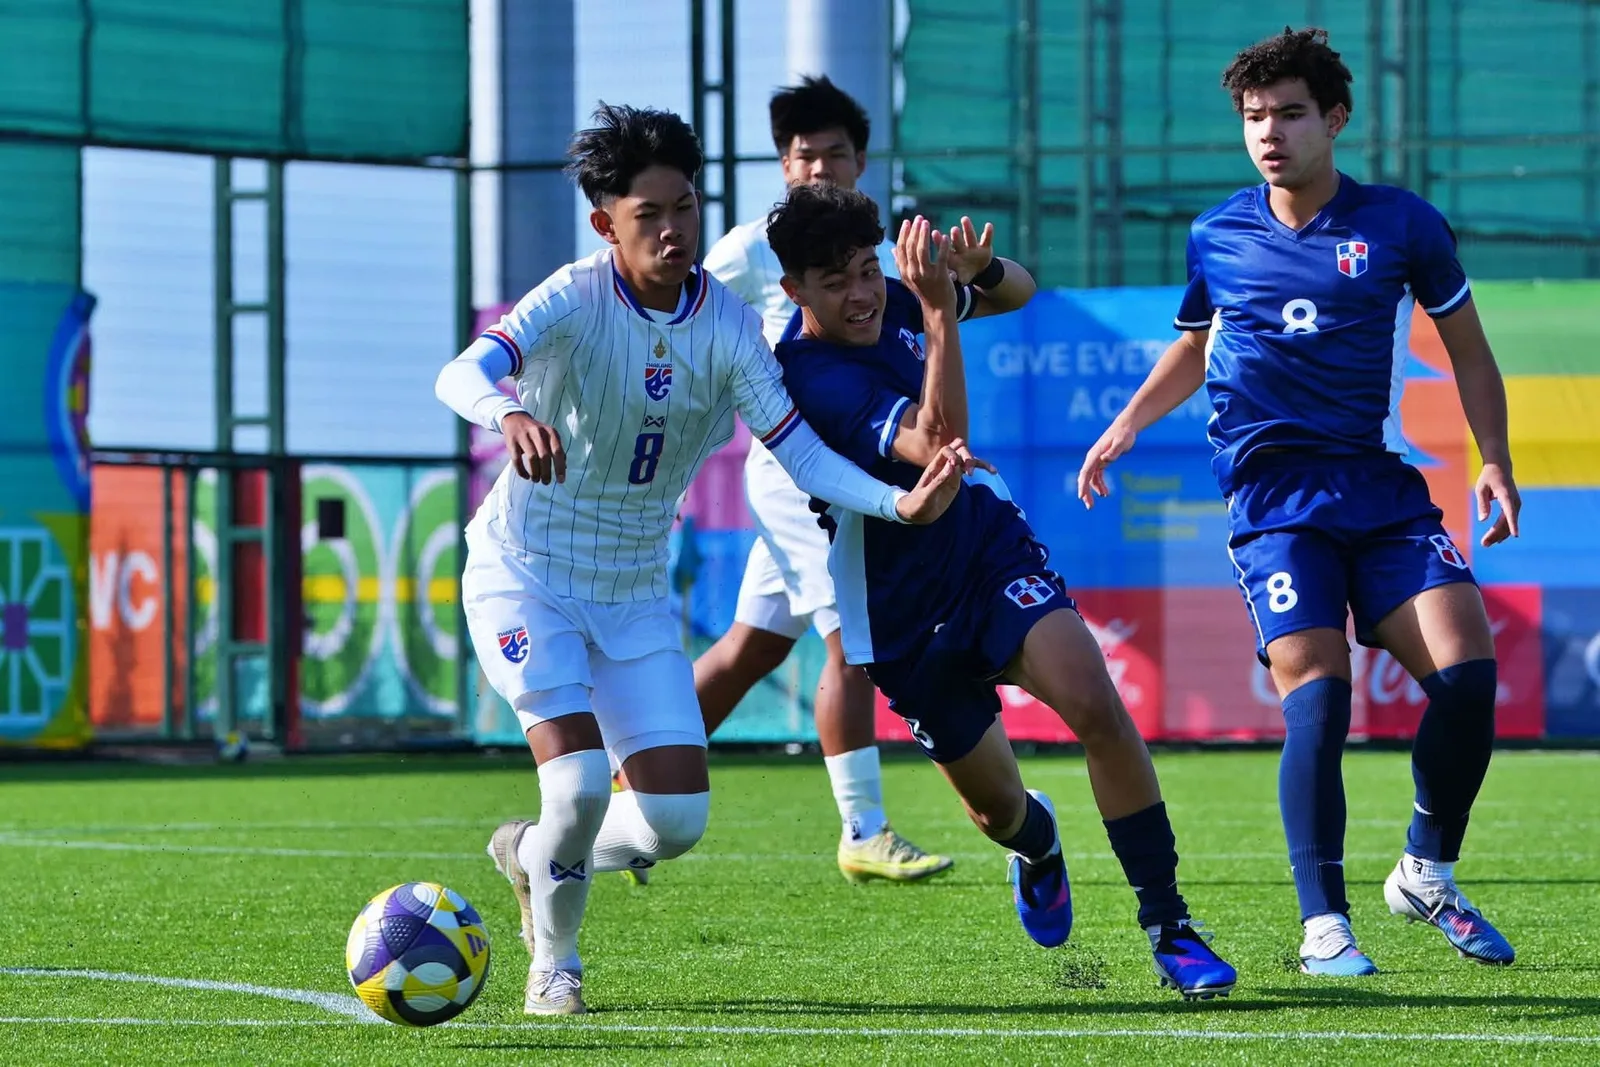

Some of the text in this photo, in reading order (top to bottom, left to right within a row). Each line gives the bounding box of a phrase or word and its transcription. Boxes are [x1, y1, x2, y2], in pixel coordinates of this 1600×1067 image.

[1282, 299, 1319, 334] 8
[988, 340, 1171, 377] GIVE EVER
[1068, 386, 1095, 421] A
[628, 433, 665, 485] 8
[1266, 571, 1298, 613] 8
